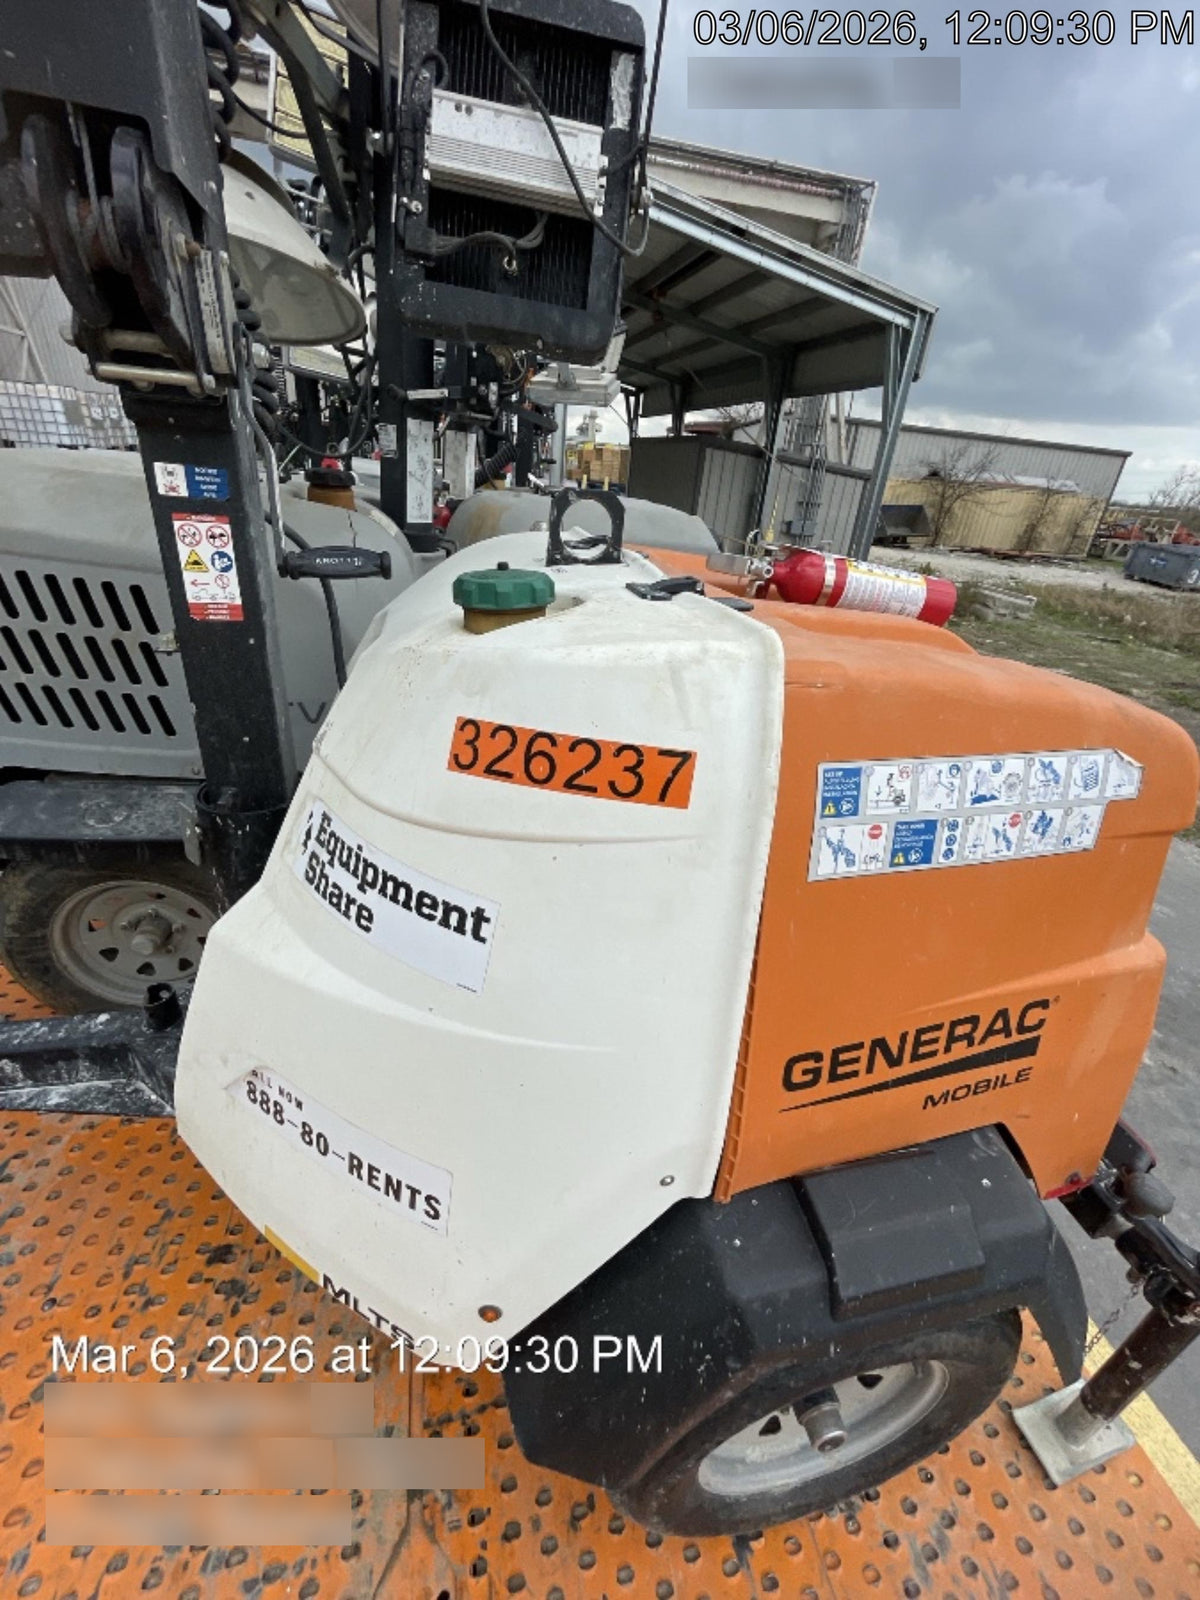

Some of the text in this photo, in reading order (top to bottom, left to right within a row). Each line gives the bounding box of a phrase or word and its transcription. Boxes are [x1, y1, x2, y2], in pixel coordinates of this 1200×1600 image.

[452, 718, 692, 803] 326237
[304, 849, 374, 934] Share
[314, 809, 491, 945] Equipment
[781, 998, 1050, 1093] GENERAC
[921, 1065, 1034, 1110] MOBILE
[278, 1085, 304, 1112] NOW
[246, 1079, 443, 1221] 888-80-RENTS
